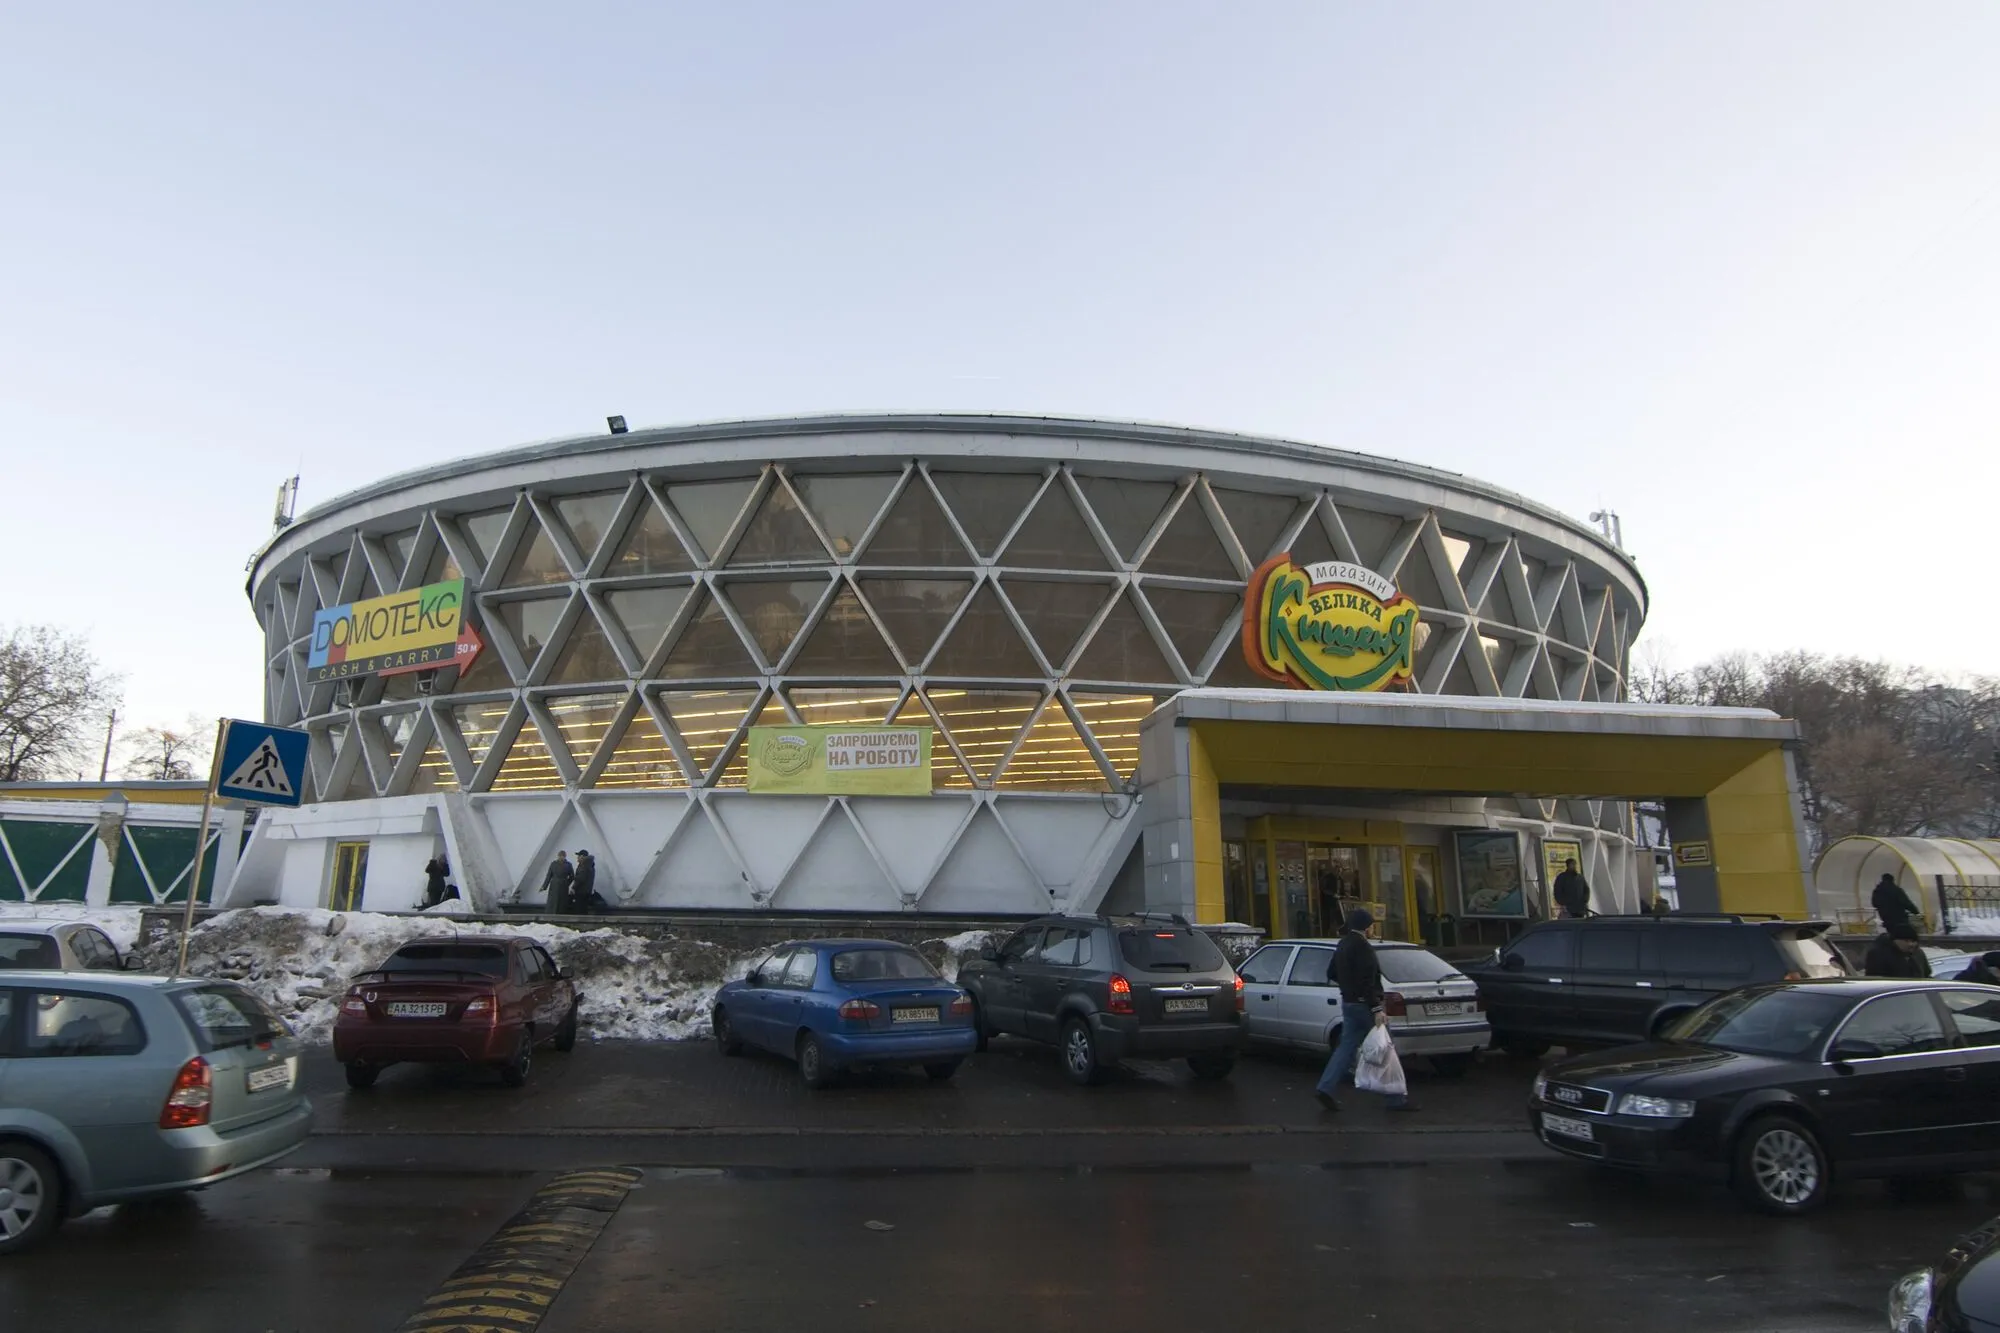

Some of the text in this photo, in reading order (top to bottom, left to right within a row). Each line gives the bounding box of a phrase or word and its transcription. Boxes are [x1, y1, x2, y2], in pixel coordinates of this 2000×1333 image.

[1316, 565, 1387, 594] магазин
[1309, 593, 1382, 622] ВЕЛИКА
[457, 643, 468, 655] 50
[319, 648, 443, 680] CASH & CARRY
[827, 733, 918, 748] ЗАПРОШУЄМО
[828, 749, 918, 766] НА РОБОТУ
